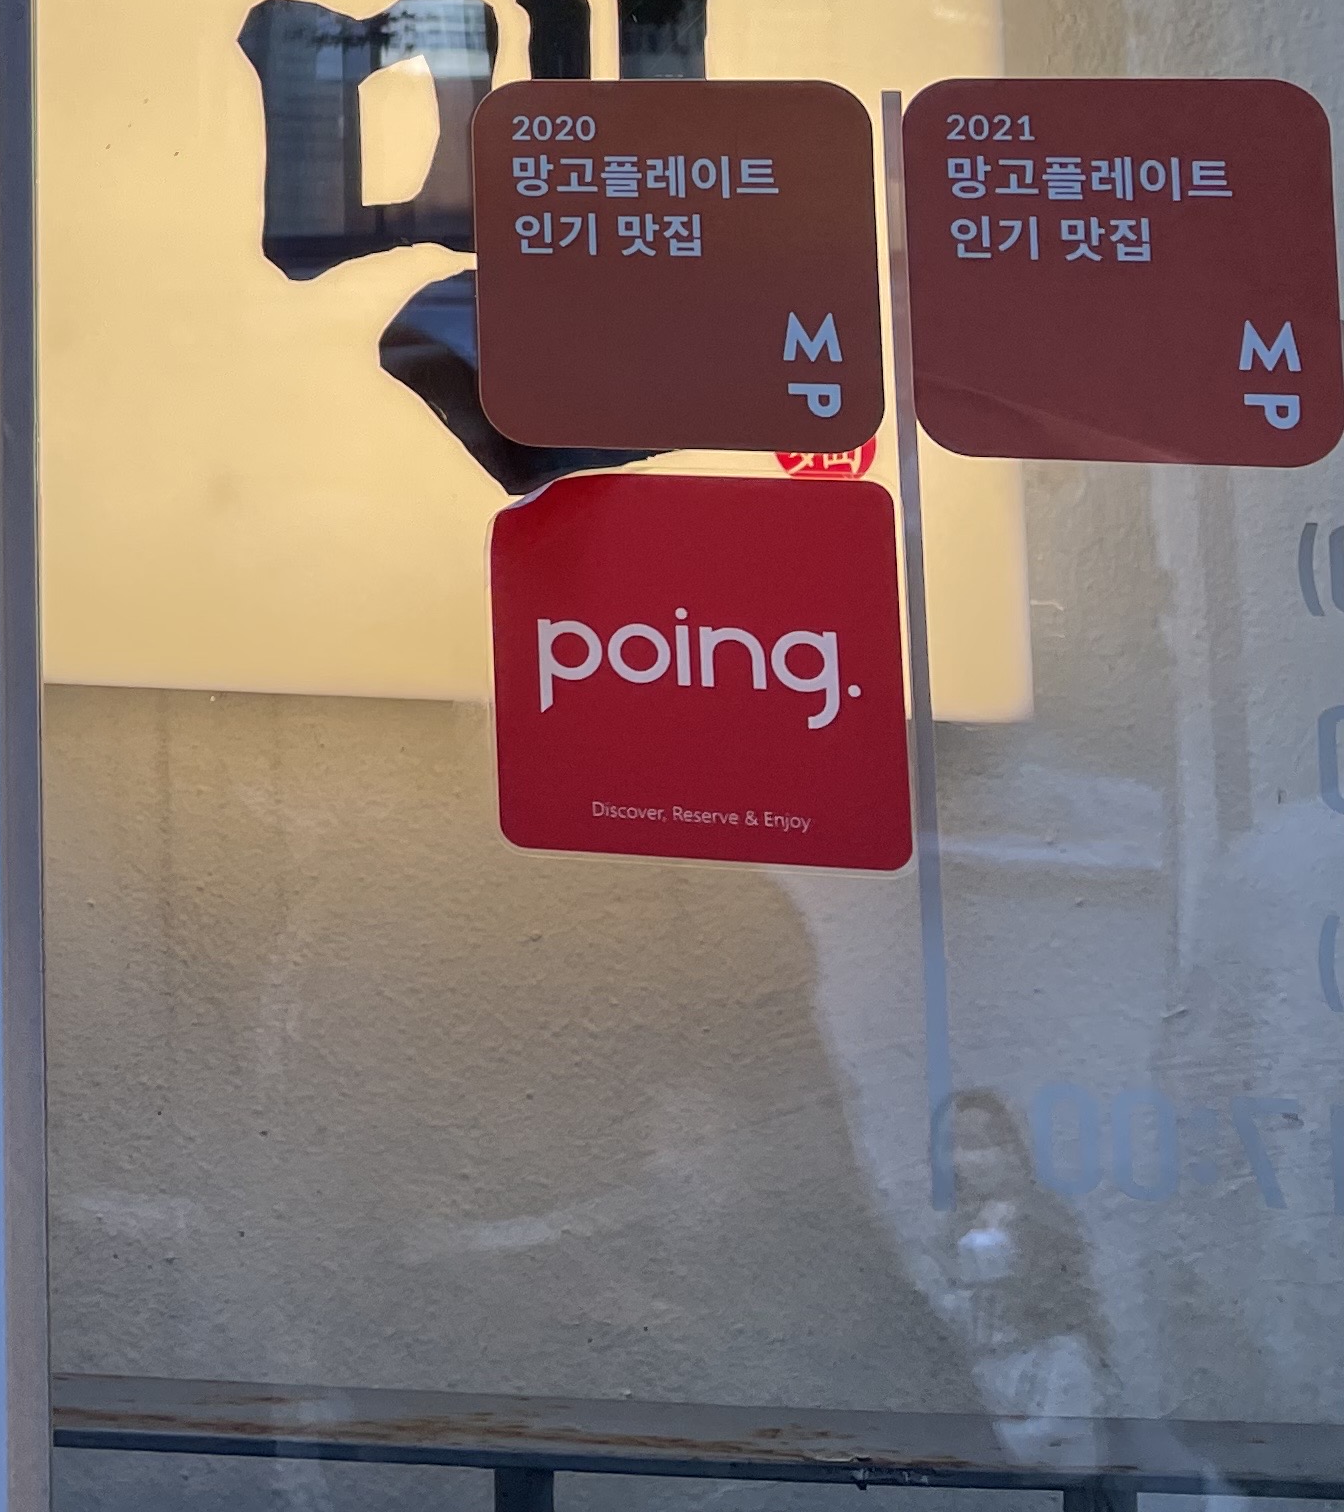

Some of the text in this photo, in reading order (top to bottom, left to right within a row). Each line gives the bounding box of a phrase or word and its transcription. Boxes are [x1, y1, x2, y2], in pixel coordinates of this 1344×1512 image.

[511, 114, 597, 142] 2020
[945, 113, 1036, 141] 2021
[511, 154, 780, 200] 망고플레이트
[946, 155, 1234, 202] 망고플레이트
[514, 212, 703, 258] 인기 맛집
[949, 215, 1152, 263] 인기 맛집
[672, 805, 740, 826] Reserve
[744, 809, 760, 827] &
[764, 810, 812, 834] Enjoy
